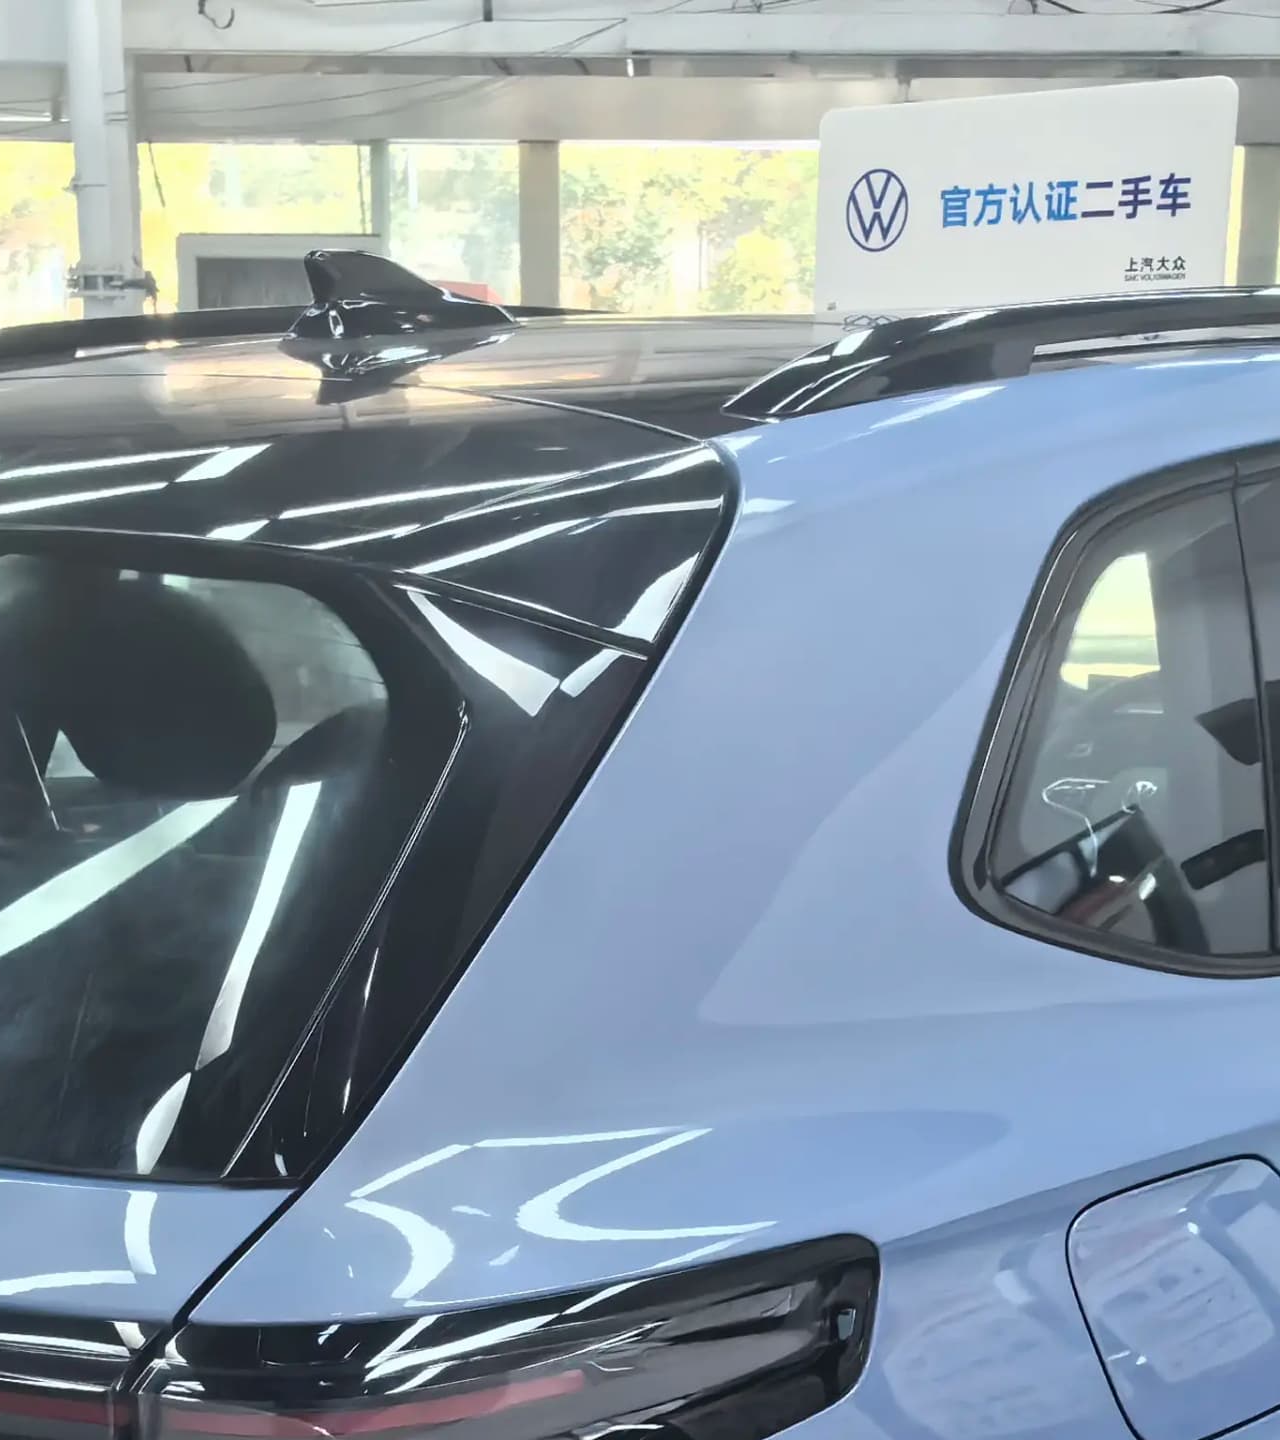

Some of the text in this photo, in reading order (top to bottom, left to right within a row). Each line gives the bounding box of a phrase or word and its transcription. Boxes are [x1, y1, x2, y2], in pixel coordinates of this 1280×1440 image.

[939, 172, 1192, 229] 官方认证二手车
[1124, 255, 1186, 272] 上汽大众
